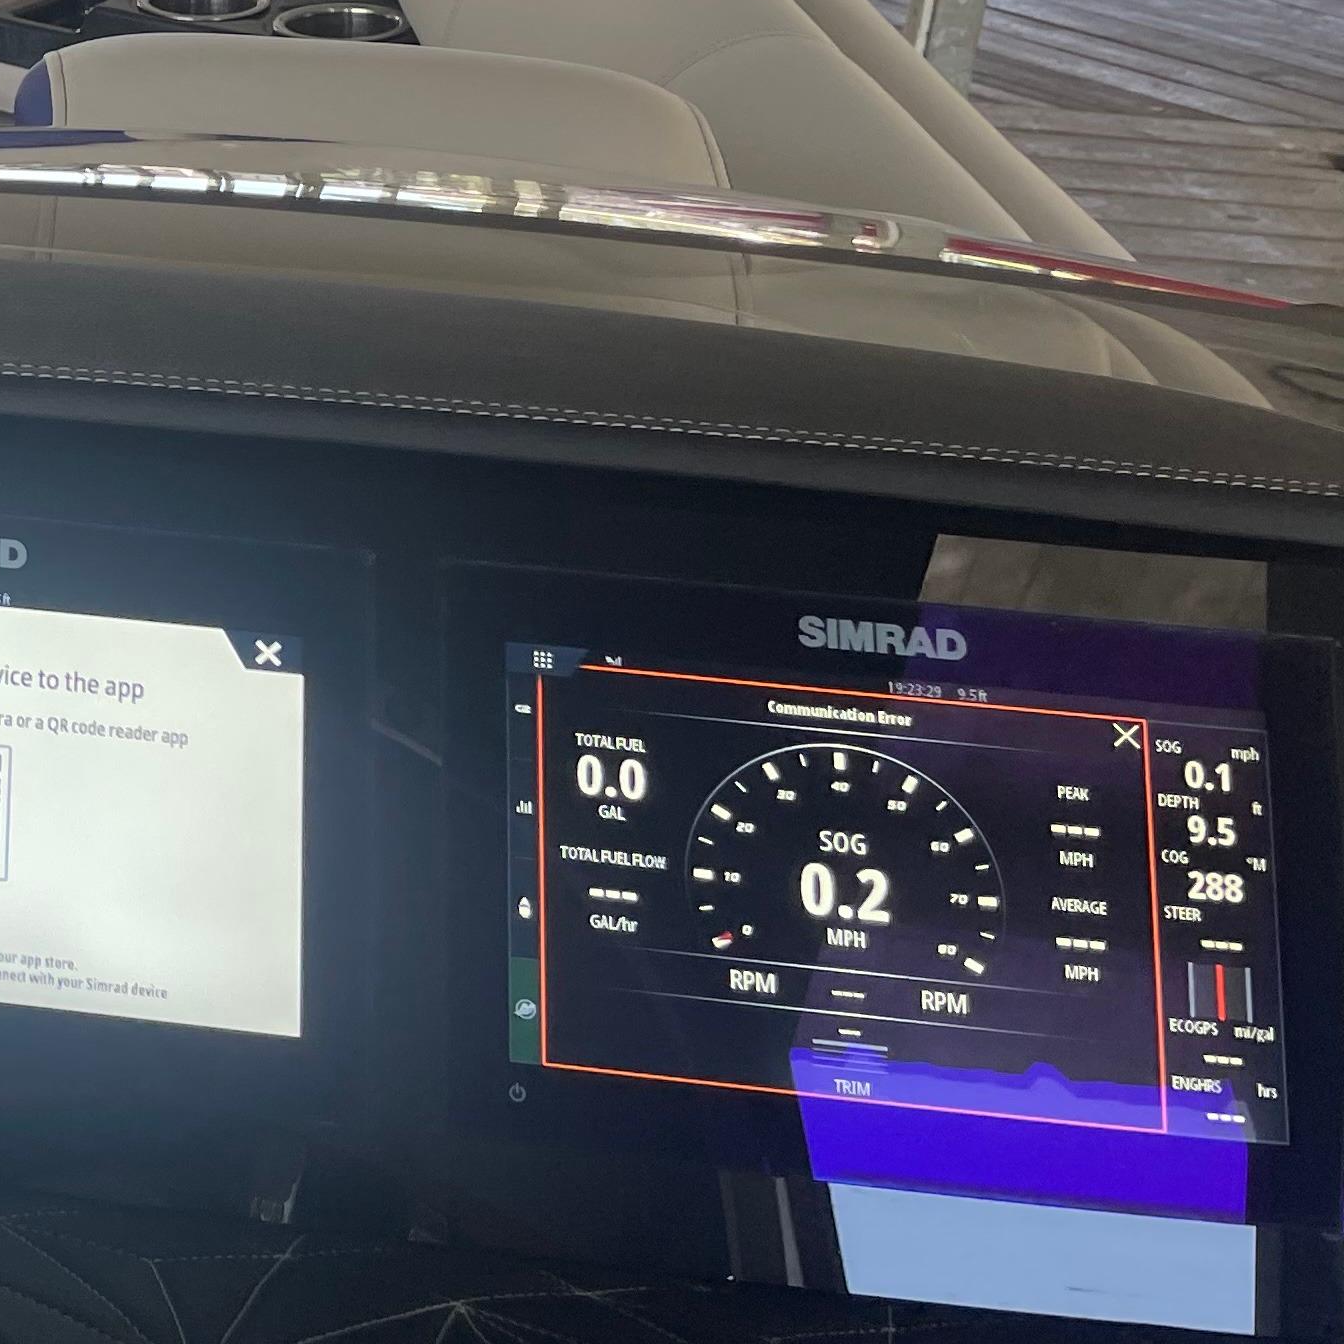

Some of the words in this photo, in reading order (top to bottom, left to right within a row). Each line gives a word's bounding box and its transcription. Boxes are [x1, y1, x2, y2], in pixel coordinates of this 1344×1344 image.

[798, 615, 967, 661] SIMRAD
[38, 669, 59, 690] to
[65, 671, 100, 694] the
[105, 679, 145, 704] app
[888, 680, 942, 698] 19:23:29
[767, 700, 875, 723] Communication
[877, 711, 912, 727] Error
[16, 715, 32, 729] or
[35, 717, 45, 730] a
[47, 717, 69, 734] QR
[71, 721, 106, 737] code
[109, 724, 158, 742] reader
[161, 732, 189, 749] app
[575, 732, 615, 750] TOTAL
[616, 736, 646, 753] FUEL
[1155, 739, 1182, 754] SOG
[1231, 747, 1260, 762] mph
[576, 754, 646, 800] 0.0
[1184, 760, 1230, 792] 0.1
[1057, 785, 1090, 801] PEAK
[1157, 793, 1200, 810] DEPTH
[598, 804, 627, 822] GAL
[735, 821, 756, 834] 20
[1187, 814, 1236, 846] 9.5
[818, 830, 867, 856] SOG
[560, 845, 599, 863] TOTAL
[600, 850, 631, 866] FUEL
[632, 853, 667, 870] FLOW
[1059, 851, 1094, 868] MPH
[1161, 849, 1189, 865] COG
[724, 871, 741, 883] 10
[1187, 870, 1244, 903] 288
[800, 862, 890, 923] 0.2
[1051, 897, 1107, 915] AVERAGE
[1163, 905, 1202, 922] STEER
[589, 914, 638, 933] GAL/hr
[827, 927, 867, 949] MPH
[20, 956, 42, 969] app
[45, 957, 78, 971] store.
[1064, 964, 1099, 982] MPH
[29, 972, 55, 987] with
[57, 977, 84, 990] your
[86, 977, 128, 995] Simrad
[131, 982, 168, 999] device
[729, 968, 778, 994] RPM
[921, 990, 968, 1015] RPM
[1169, 1017, 1219, 1036] ECOGPS
[834, 1078, 871, 1097] TRIM
[1171, 1075, 1223, 1094] ENGHRS
[1256, 1082, 1278, 1099] hrs
